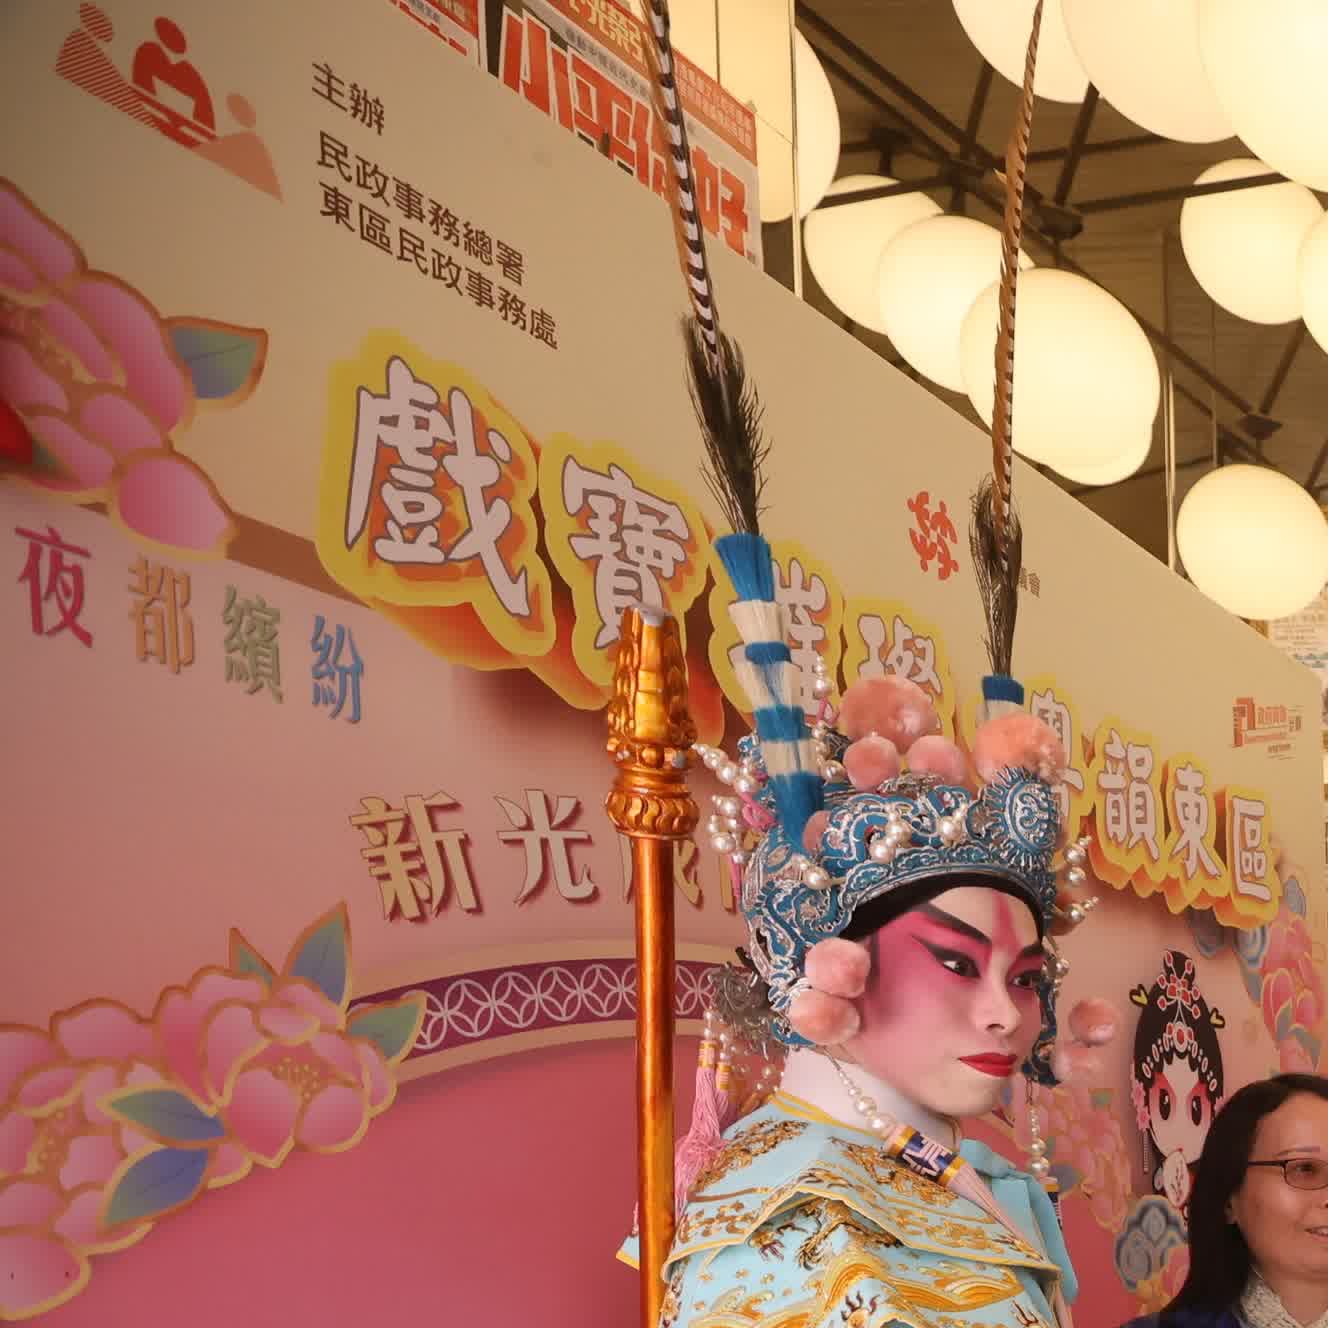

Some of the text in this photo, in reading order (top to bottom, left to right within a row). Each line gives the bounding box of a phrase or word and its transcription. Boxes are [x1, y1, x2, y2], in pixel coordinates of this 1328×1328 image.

[312, 62, 384, 136] 主辦
[317, 130, 524, 286] 民政事務總署
[319, 181, 558, 350] 東區民政事務處
[14, 526, 364, 724] 夜都繽紛
